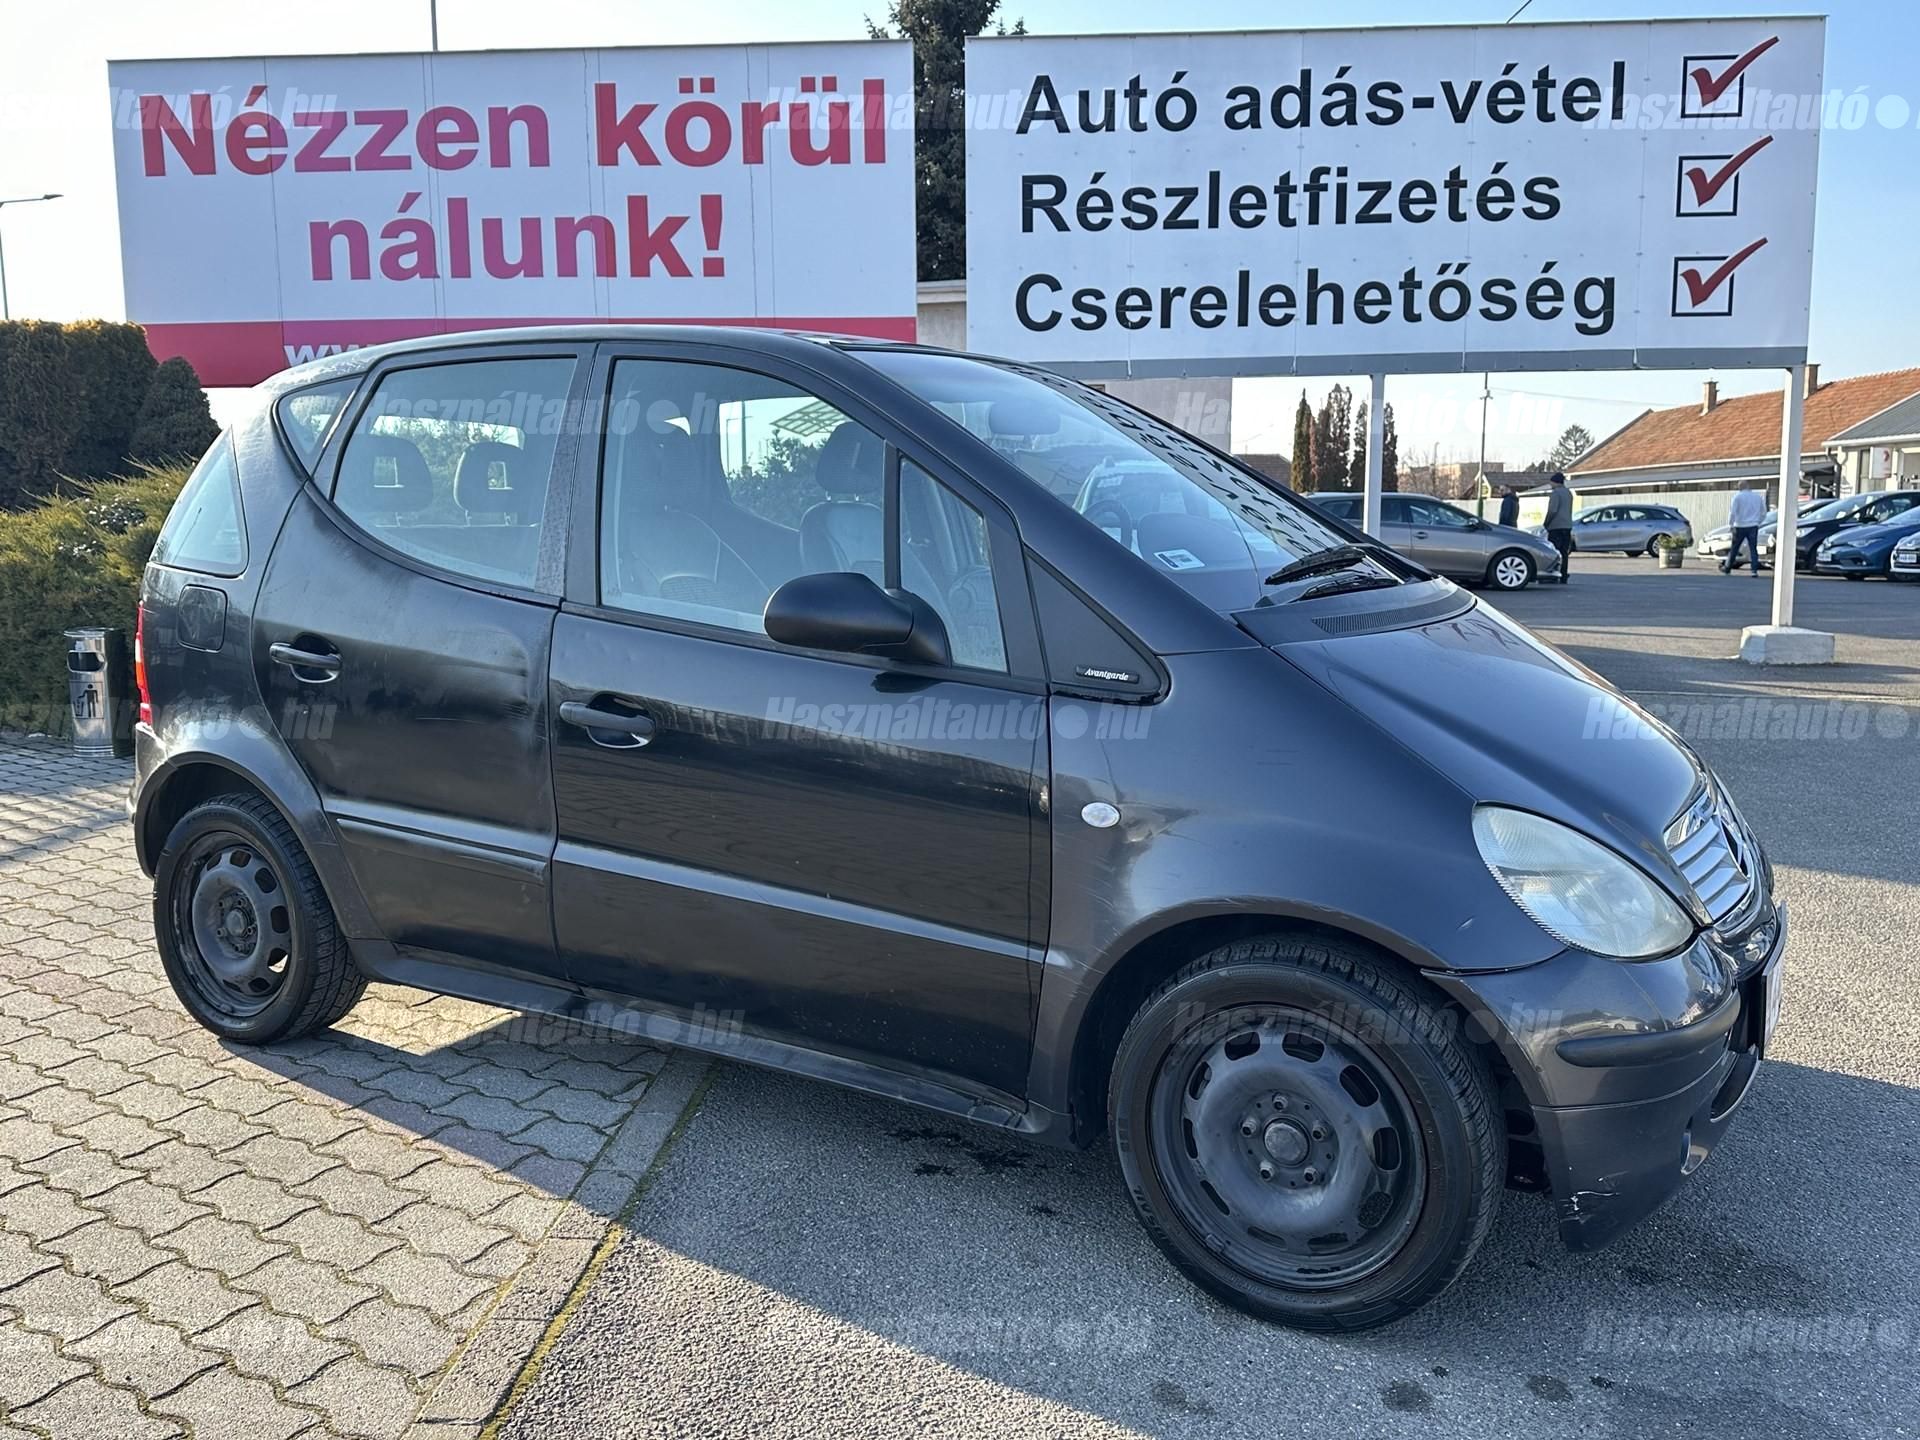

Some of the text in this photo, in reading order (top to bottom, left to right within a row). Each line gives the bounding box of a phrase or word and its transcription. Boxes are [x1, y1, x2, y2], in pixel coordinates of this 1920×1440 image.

[142, 77, 886, 178] Nézzen körül
[1015, 61, 1626, 136] Autó adás-vétel
[1020, 162, 1562, 233] Részletfizetés
[310, 193, 725, 281] nálunk!
[1014, 259, 1616, 336] Cserelehetőség
[1084, 667, 1129, 681] Avantgarde
